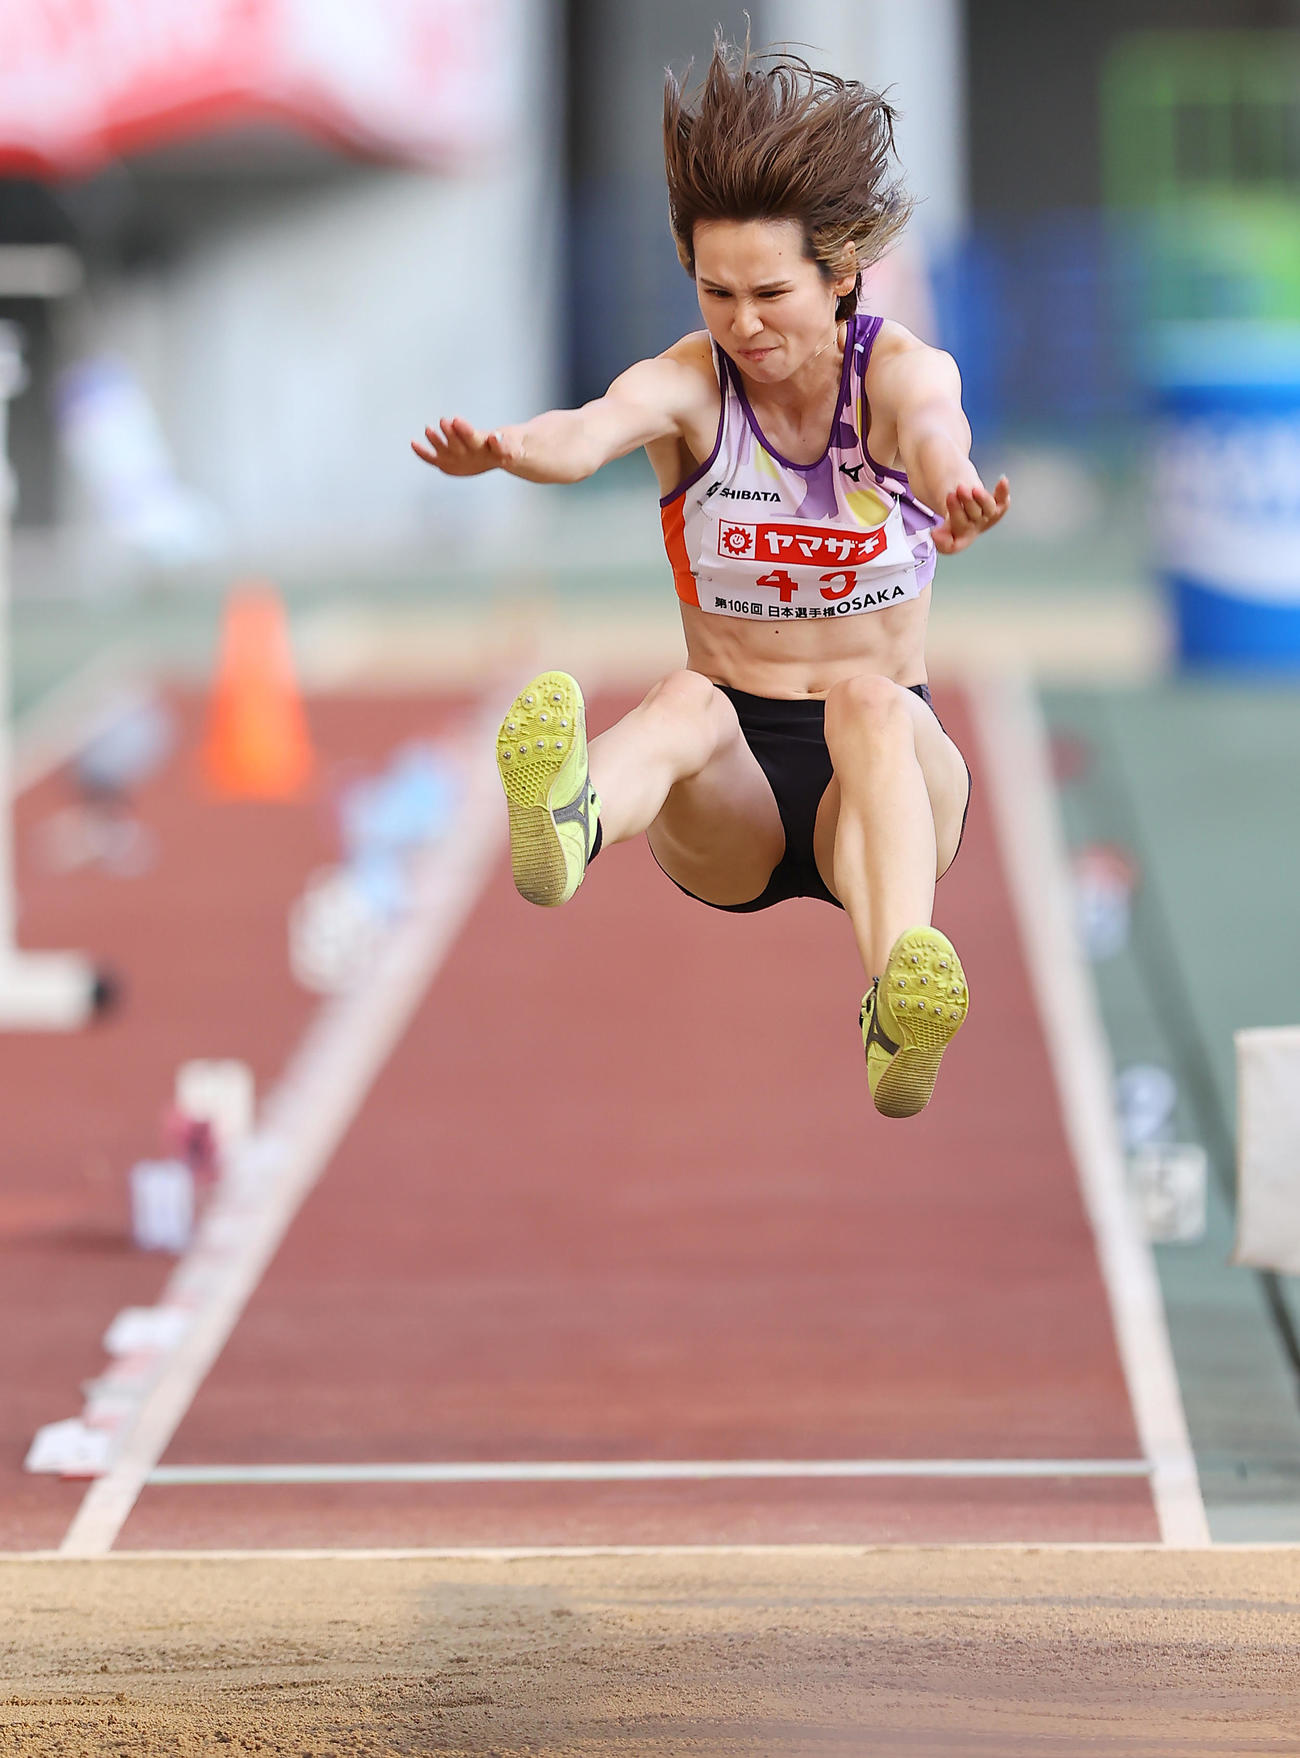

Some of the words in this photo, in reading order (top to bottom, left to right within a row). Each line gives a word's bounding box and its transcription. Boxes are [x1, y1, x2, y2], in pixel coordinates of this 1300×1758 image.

[719, 487, 782, 503] SHIBATA
[764, 531, 880, 561] ヤマザキ
[714, 596, 763, 616] 第106回
[768, 605, 837, 618] 日本選手権
[836, 585, 905, 614] OSAKA
